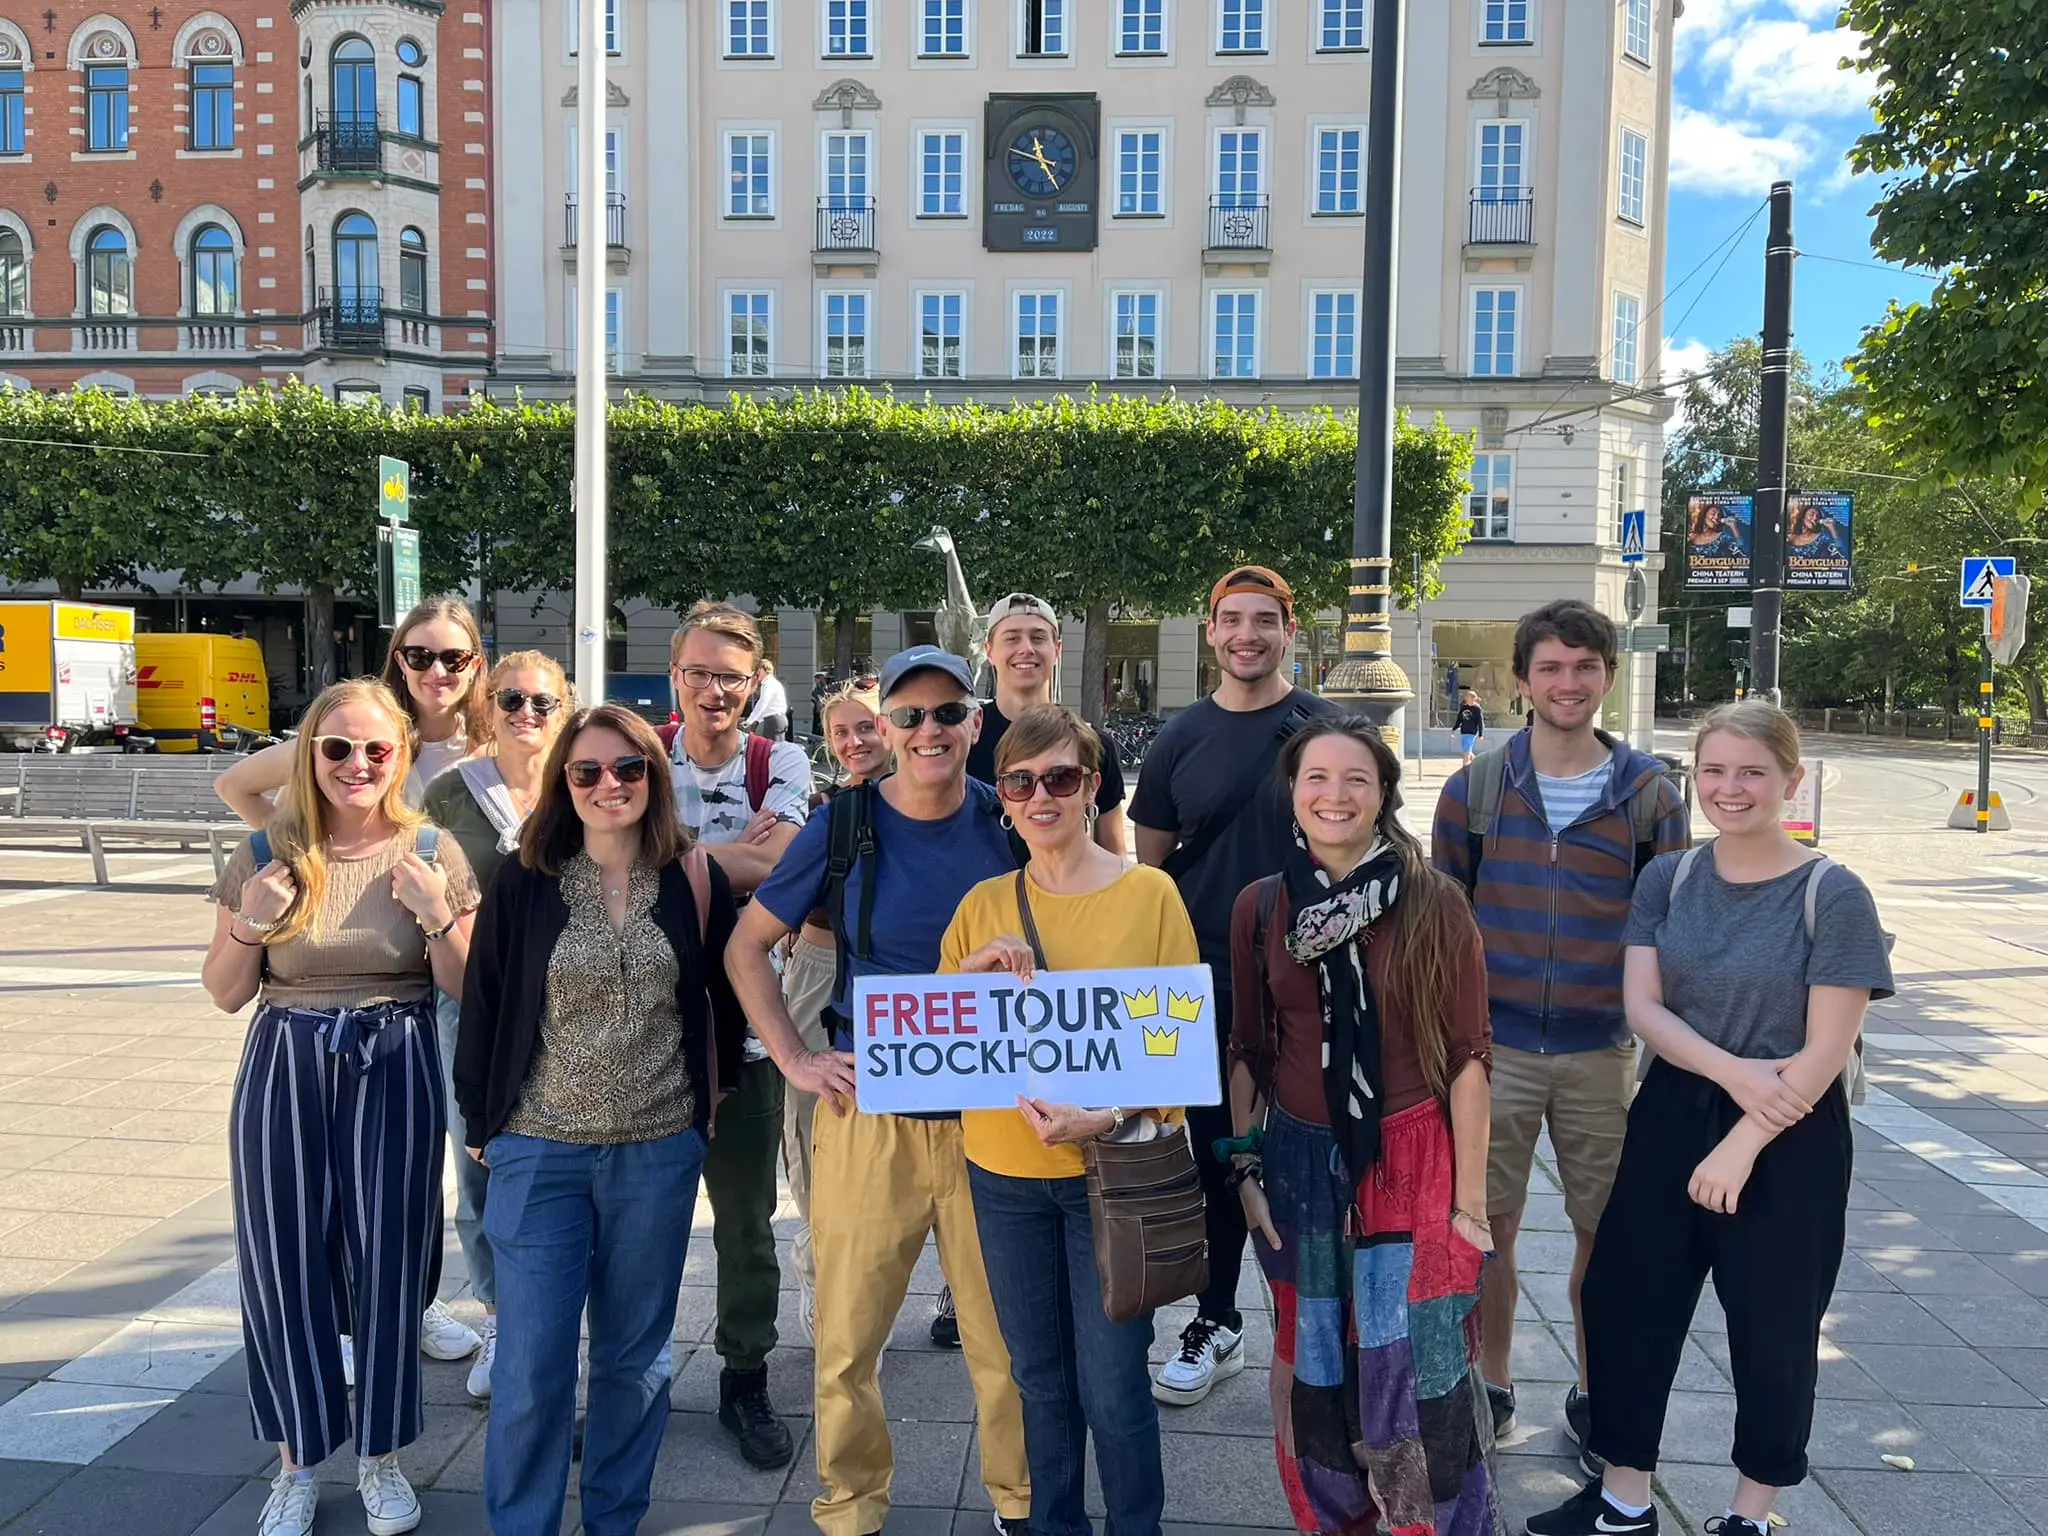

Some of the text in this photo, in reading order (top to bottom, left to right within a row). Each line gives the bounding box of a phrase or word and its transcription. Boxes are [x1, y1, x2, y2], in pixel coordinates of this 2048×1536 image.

[994, 203, 1025, 213] FREDAG
[1027, 230, 1054, 241] 2022
[1689, 555, 1750, 566] BODYGUARD
[1789, 556, 1849, 567] BODYGUARD
[73, 616, 116, 632] DACHSER
[227, 671, 259, 683] DHL
[865, 986, 1122, 1037] FREE TOUR
[867, 1038, 1122, 1077] STOCKHOLM
